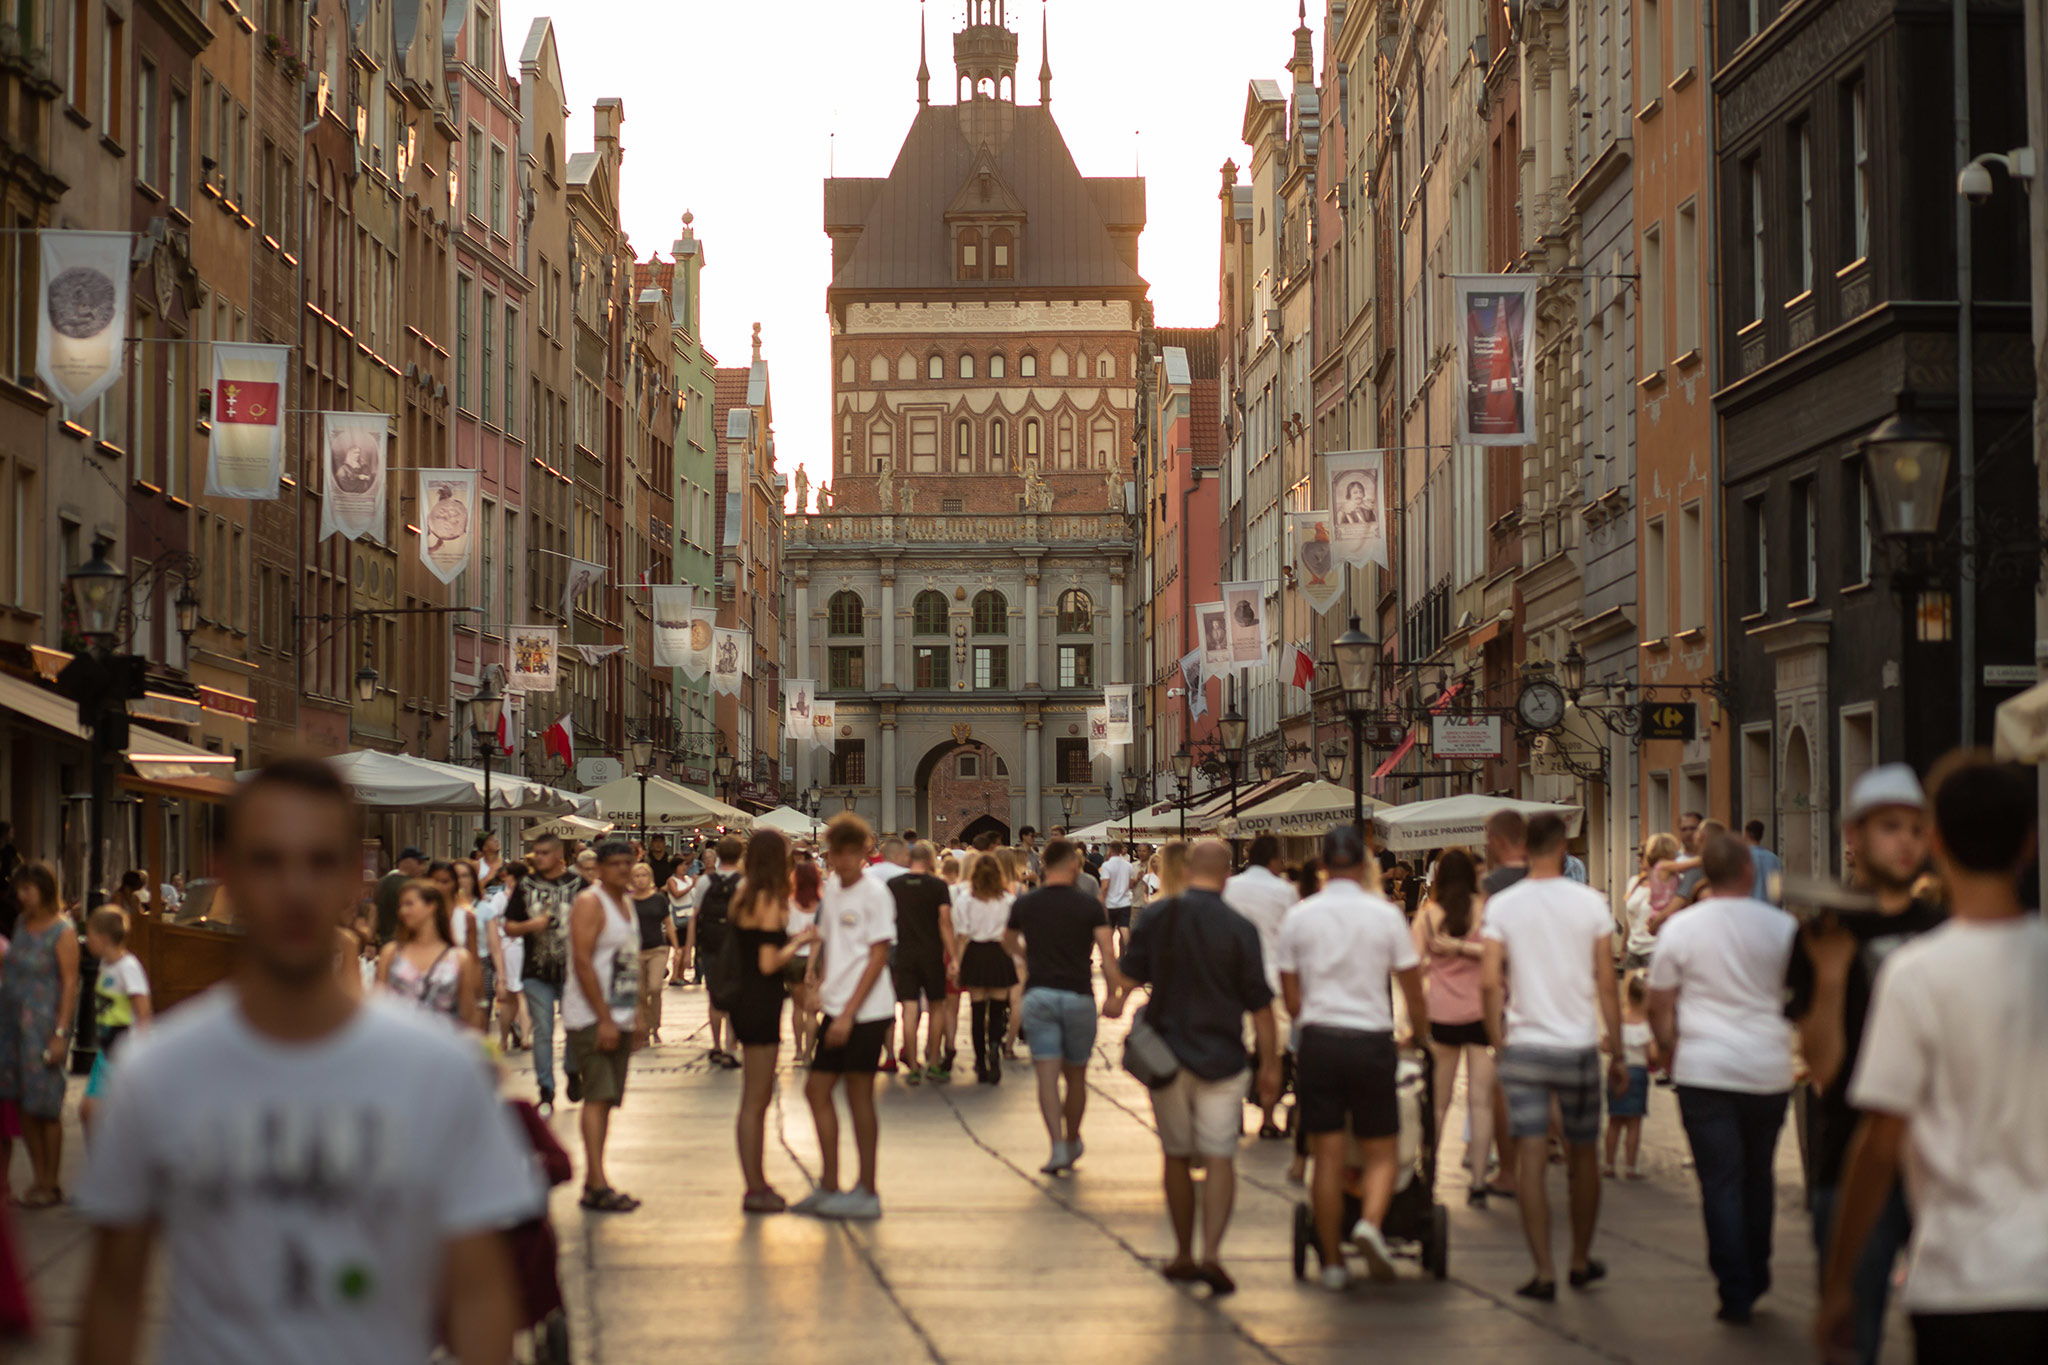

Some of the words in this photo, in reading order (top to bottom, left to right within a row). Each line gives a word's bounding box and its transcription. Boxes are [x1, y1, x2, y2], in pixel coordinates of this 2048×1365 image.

[1443, 715, 1489, 726] NOVA
[607, 811, 642, 820] CHEF
[671, 814, 693, 822] pepsi
[1238, 818, 1273, 831] LODY
[1280, 808, 1356, 826] NATURALNE
[1414, 828, 1439, 837] ZJESZ
